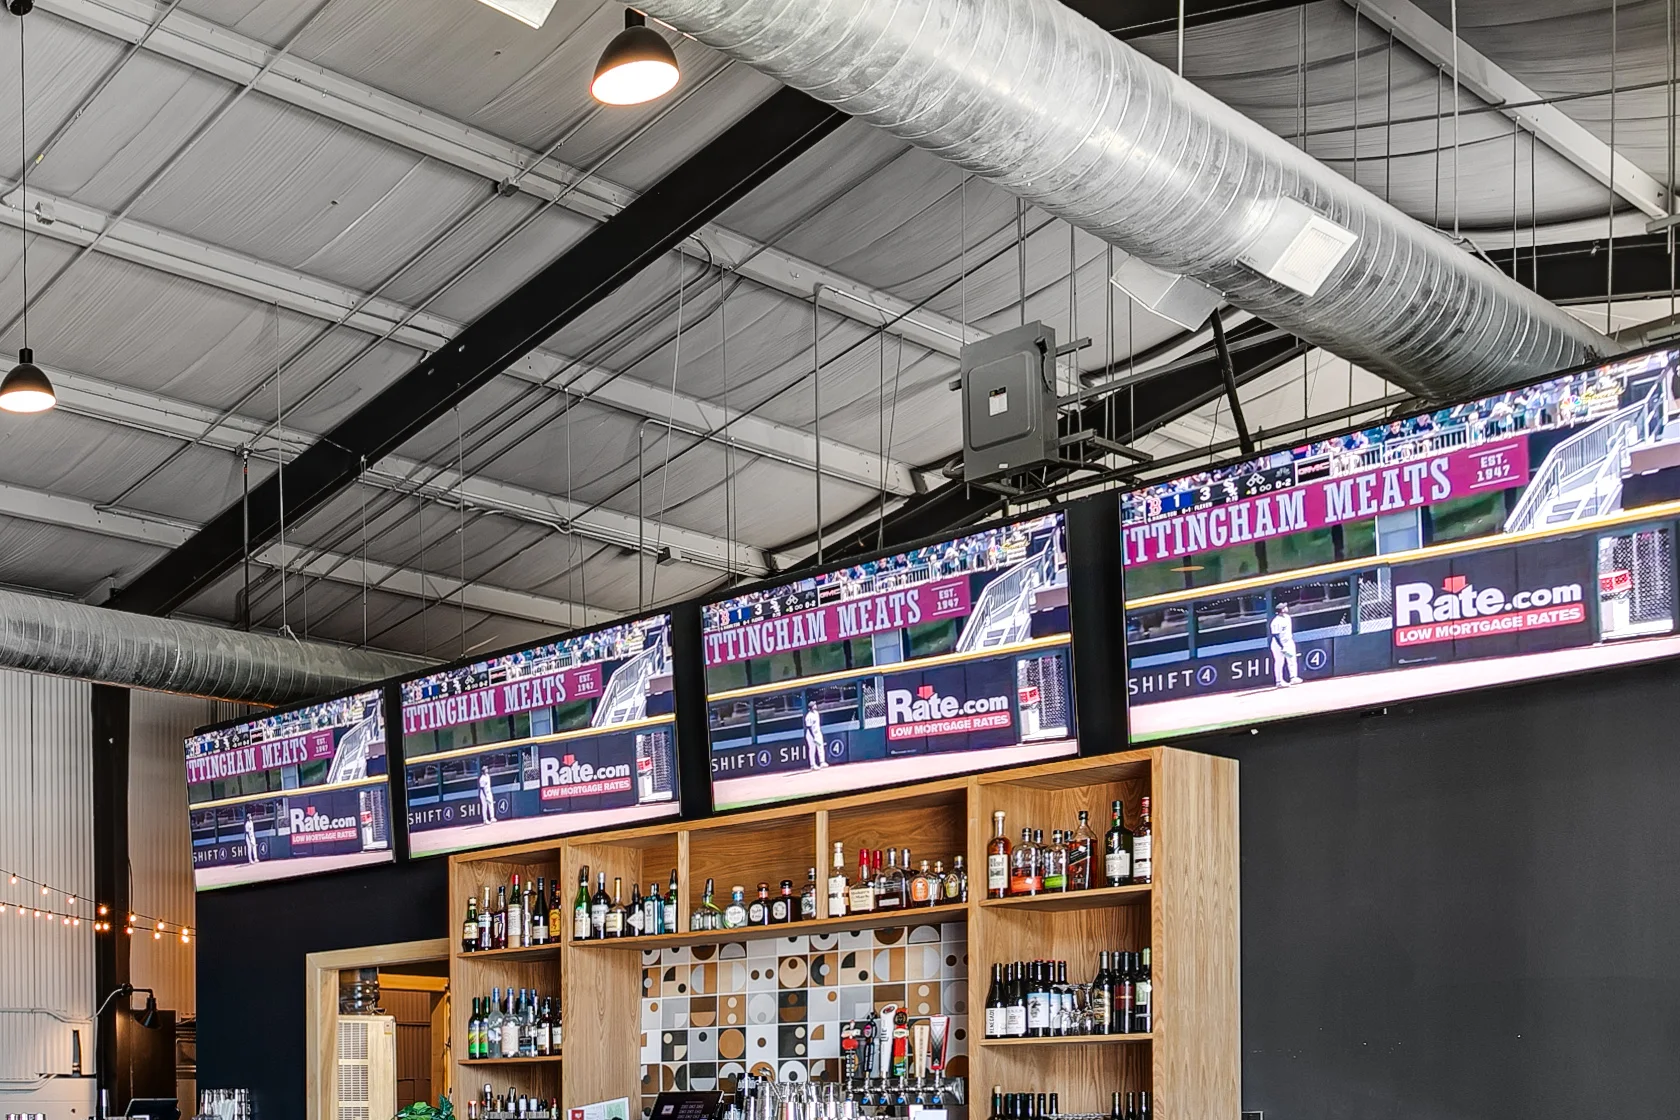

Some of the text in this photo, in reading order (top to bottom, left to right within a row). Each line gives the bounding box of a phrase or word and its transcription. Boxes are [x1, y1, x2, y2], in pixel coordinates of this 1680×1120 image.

[1480, 452, 1508, 469] EST.
[1173, 493, 1180, 507] 1
[1199, 487, 1211, 501] 3
[1275, 478, 1291, 489] 0-2
[1298, 461, 1331, 475] GMC
[1324, 457, 1452, 524] MEATS
[938, 588, 957, 600] EST.
[1395, 582, 1582, 627] Rate.com
[737, 609, 741, 619] 1
[755, 604, 762, 615] 3
[837, 589, 922, 638] MEATS
[1399, 607, 1581, 643] LOW MORTGAGE RATES
[441, 682, 448, 692] 3
[504, 674, 567, 713] MEATS
[1128, 669, 1194, 695] SHIFT
[887, 689, 1009, 724] Rate.com
[890, 715, 1009, 737] LOW MORTGAGE RATES
[261, 736, 308, 769] MEATS
[711, 752, 755, 772] SHIFT
[540, 757, 631, 787] Rate.com
[543, 780, 630, 798] LOW MORTGAGE RATES
[290, 808, 356, 833] Rate.com
[408, 809, 442, 825] SHIFT
[336, 830, 357, 840] RATES
